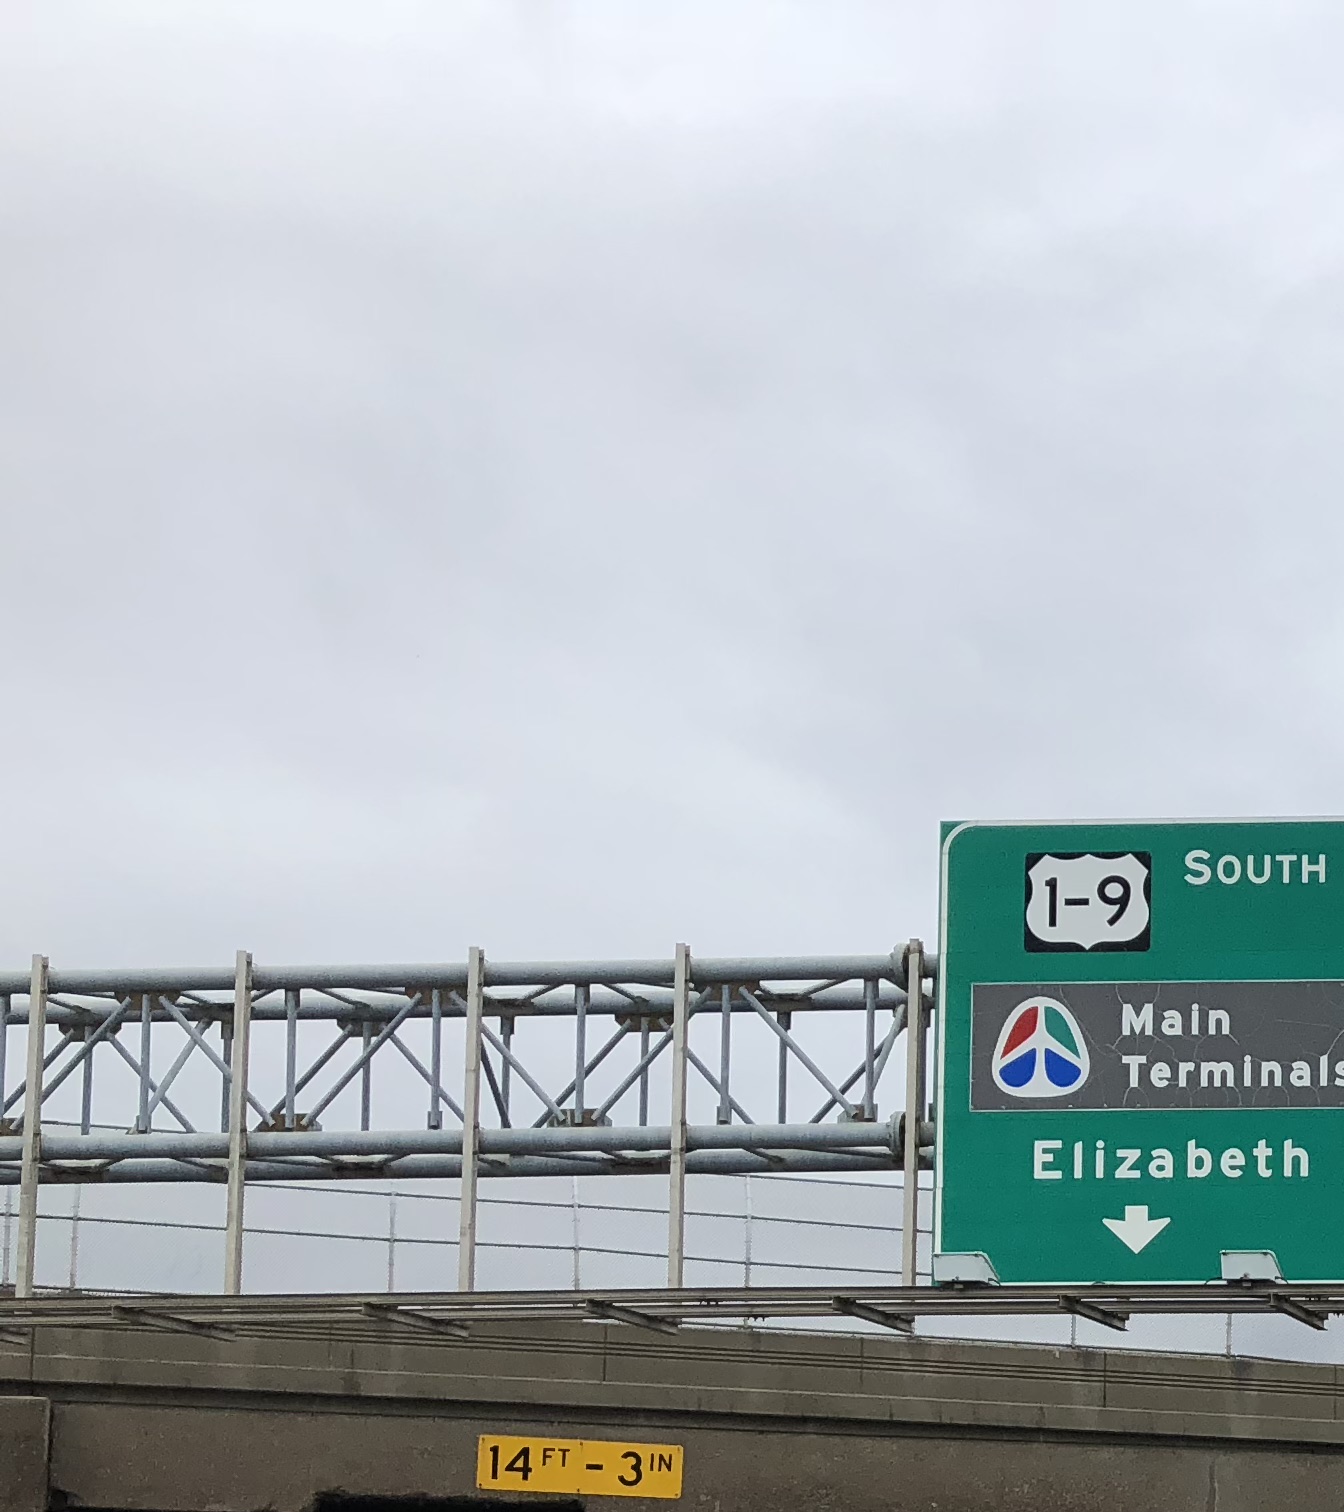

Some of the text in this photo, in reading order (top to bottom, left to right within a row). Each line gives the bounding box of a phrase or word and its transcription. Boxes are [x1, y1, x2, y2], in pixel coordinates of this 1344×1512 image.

[1183, 849, 1327, 885] SOUTH
[1045, 874, 1132, 928] 1-9
[1121, 1002, 1230, 1036] Main
[1033, 1138, 1310, 1180] Elizabeth
